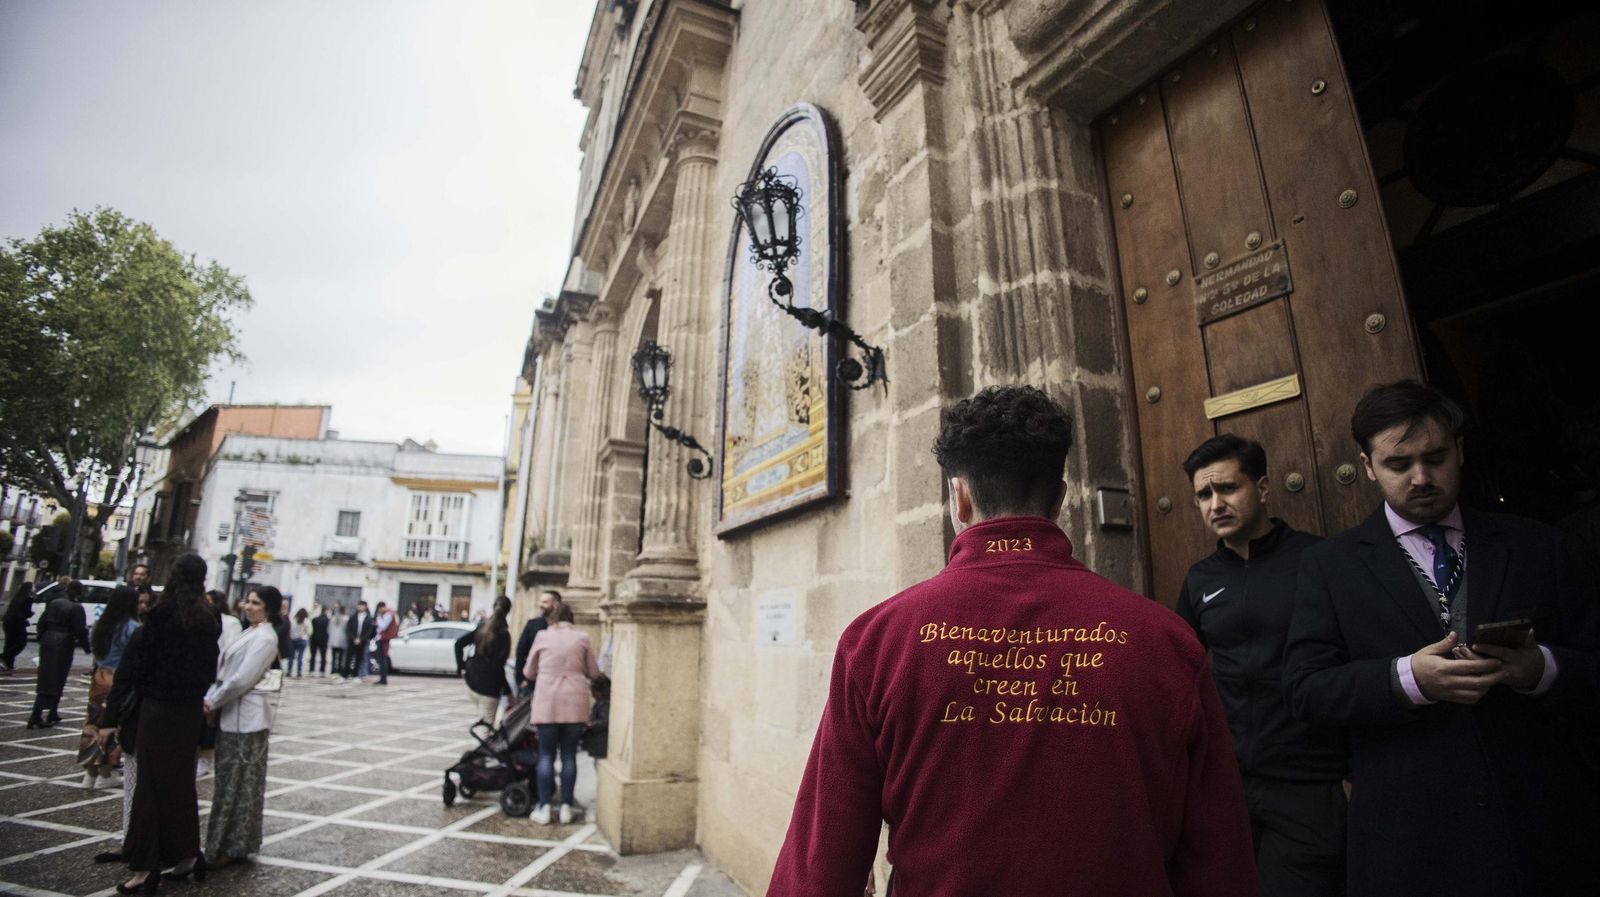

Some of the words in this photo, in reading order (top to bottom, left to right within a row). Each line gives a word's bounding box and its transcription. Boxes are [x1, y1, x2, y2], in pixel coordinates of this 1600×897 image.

[1201, 251, 1273, 288] HERMANDAD
[1243, 271, 1260, 286] DE
[1263, 263, 1280, 277] LA
[1211, 285, 1268, 315] SOLEDAD
[986, 538, 1032, 553] 2023
[919, 621, 1128, 645] Bienaventurados
[947, 647, 1047, 675] aquellos
[1060, 651, 1104, 678] que
[973, 677, 1038, 696] creen
[1051, 677, 1079, 696] en
[940, 701, 975, 723] La
[989, 699, 1117, 726] Salvación
